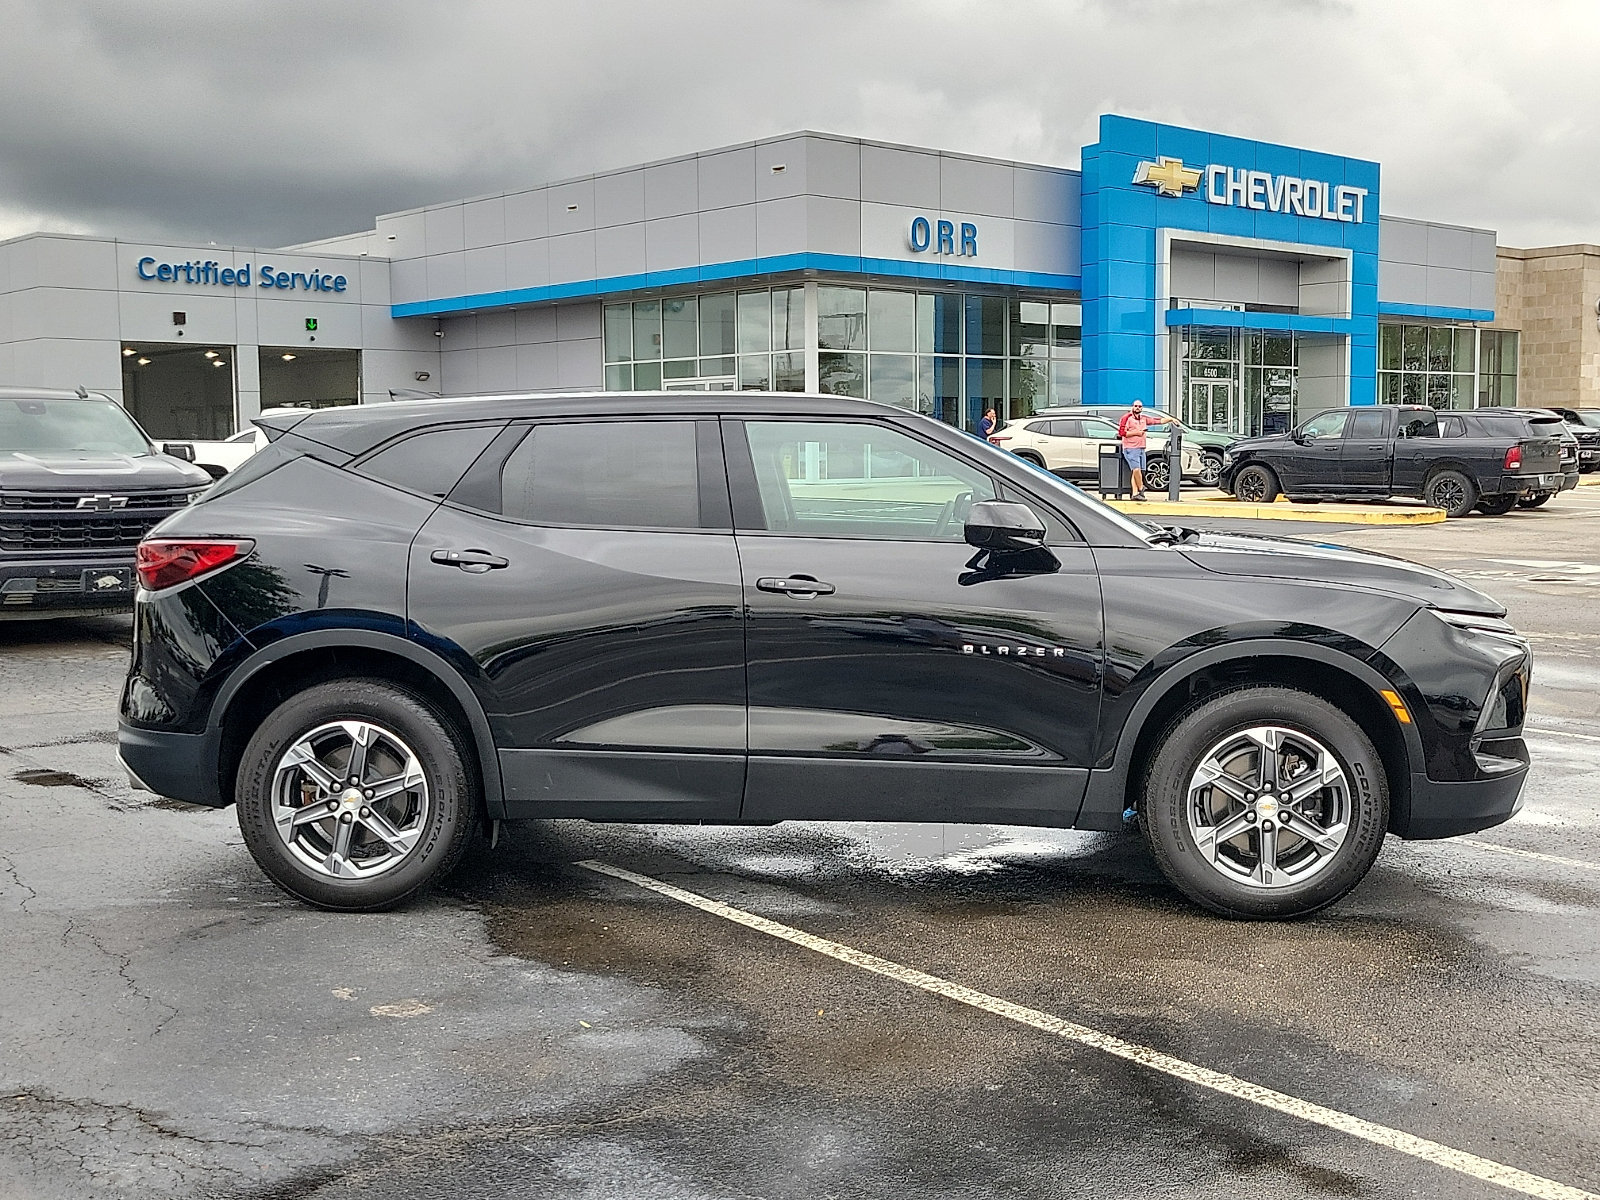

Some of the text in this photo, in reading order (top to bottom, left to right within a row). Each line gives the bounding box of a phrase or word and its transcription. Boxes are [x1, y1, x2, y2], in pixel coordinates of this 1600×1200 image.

[1205, 164, 1368, 224] CHEVROLET
[910, 216, 978, 257] ORR
[137, 256, 347, 292] Certified Service
[963, 644, 1065, 657] BLAZER
